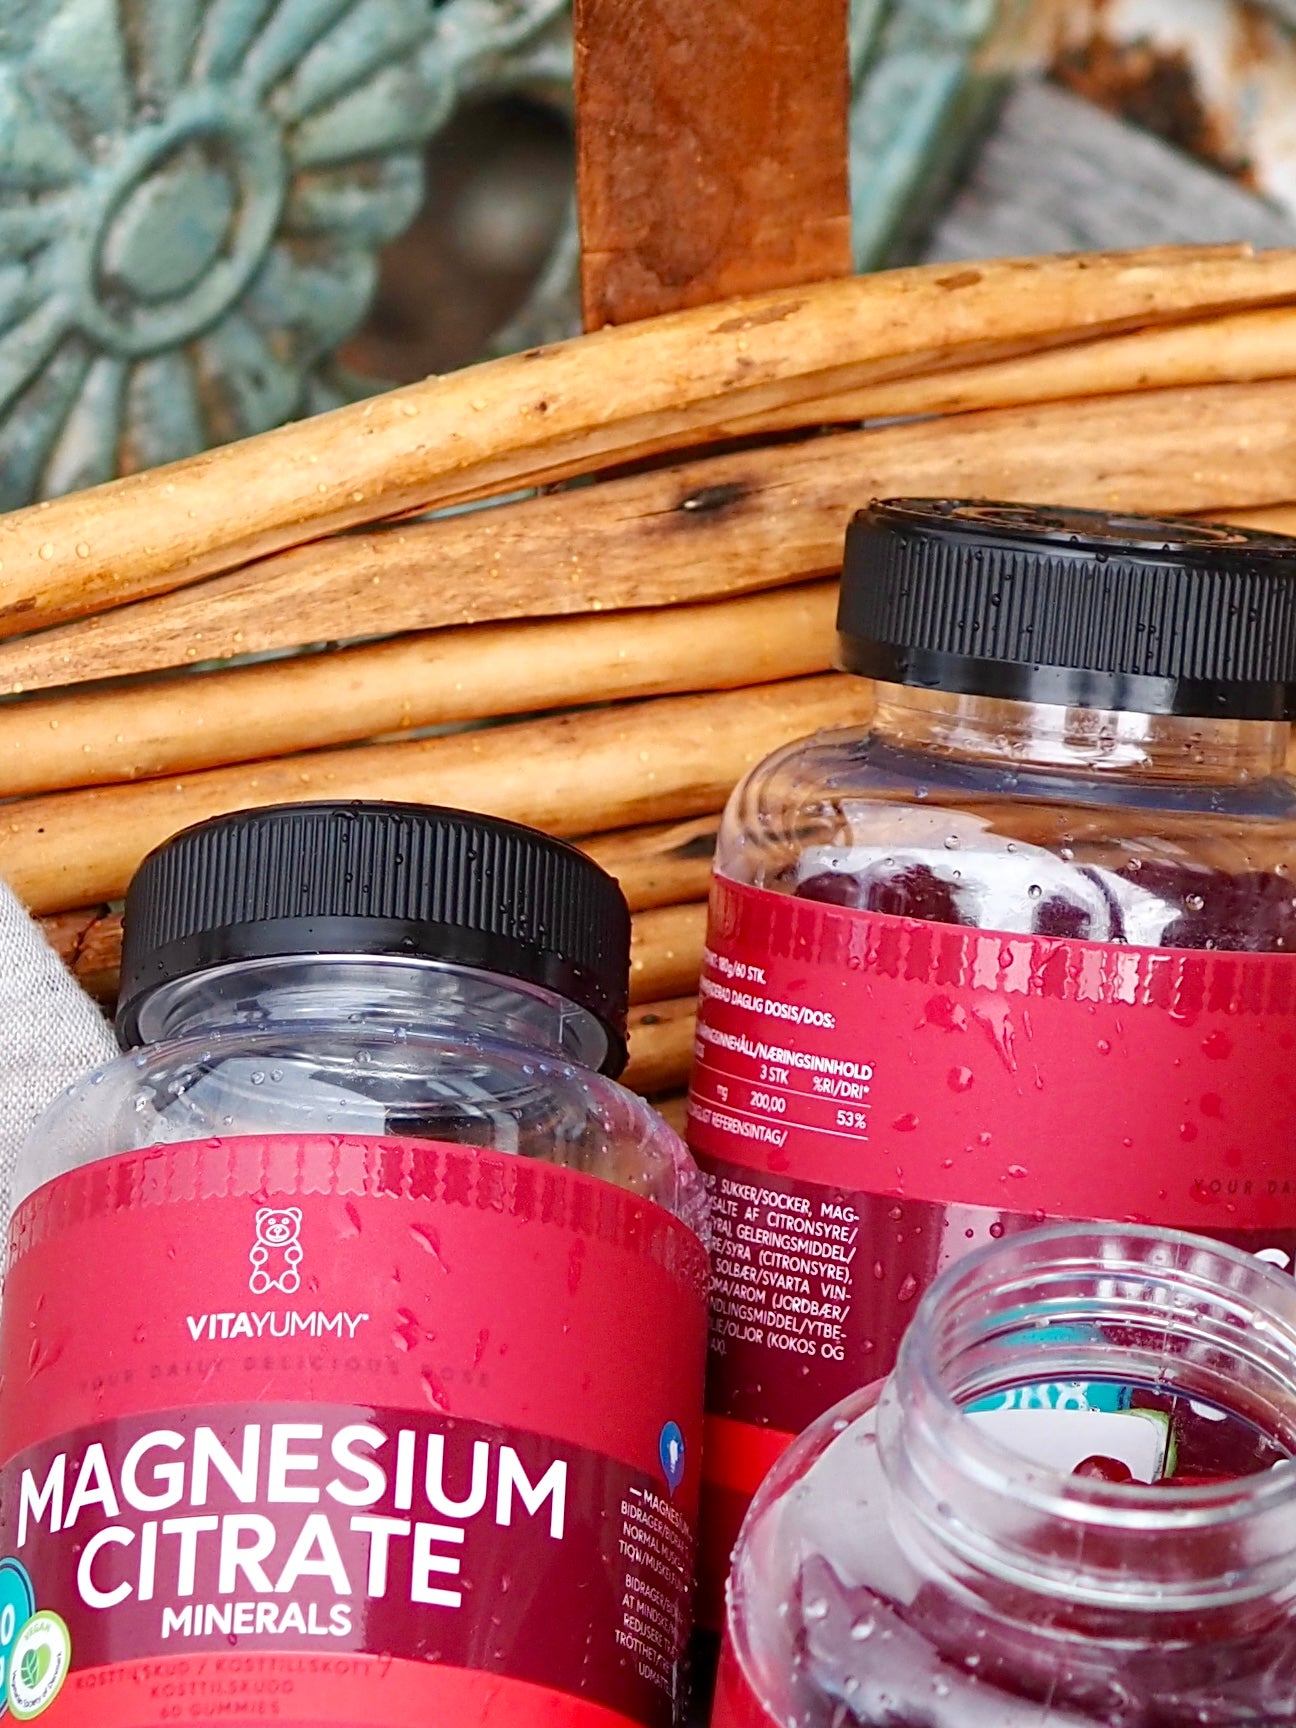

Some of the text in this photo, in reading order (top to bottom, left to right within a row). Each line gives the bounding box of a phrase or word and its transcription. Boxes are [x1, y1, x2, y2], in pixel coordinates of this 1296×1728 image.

[748, 966, 766, 985] STK.
[731, 989, 763, 1013] DAGLIG
[764, 999, 836, 1029] DOSIS/DOS:
[760, 1065, 767, 1080] 3
[769, 1068, 789, 1085] STK
[716, 1084, 867, 1130] mg 200,00 53%
[721, 1178, 813, 1218] SUKKER/SOCKER,
[820, 1203, 860, 1223] MAG-
[736, 1224, 857, 1264] GELERINGSMIDDEL/
[744, 1206, 760, 1222] AF
[767, 1212, 859, 1245] CITRONSYRE/
[716, 1258, 852, 1302] SOLBÆR/SVARTA VIN-
[758, 1249, 853, 1285] (CITRONSYRE),
[186, 1310, 368, 1341] VITAYUMMY
[771, 1293, 851, 1323] (JORDBÆR/
[767, 1332, 816, 1356] (KOKOS
[821, 1343, 845, 1361] OG
[17, 1423, 567, 1548] MAGNESIUM
[623, 1521, 660, 1554] NORMAL
[76, 1513, 465, 1609] CITRATE
[162, 1601, 352, 1639] MINERALS
[622, 1593, 635, 1610] AT
